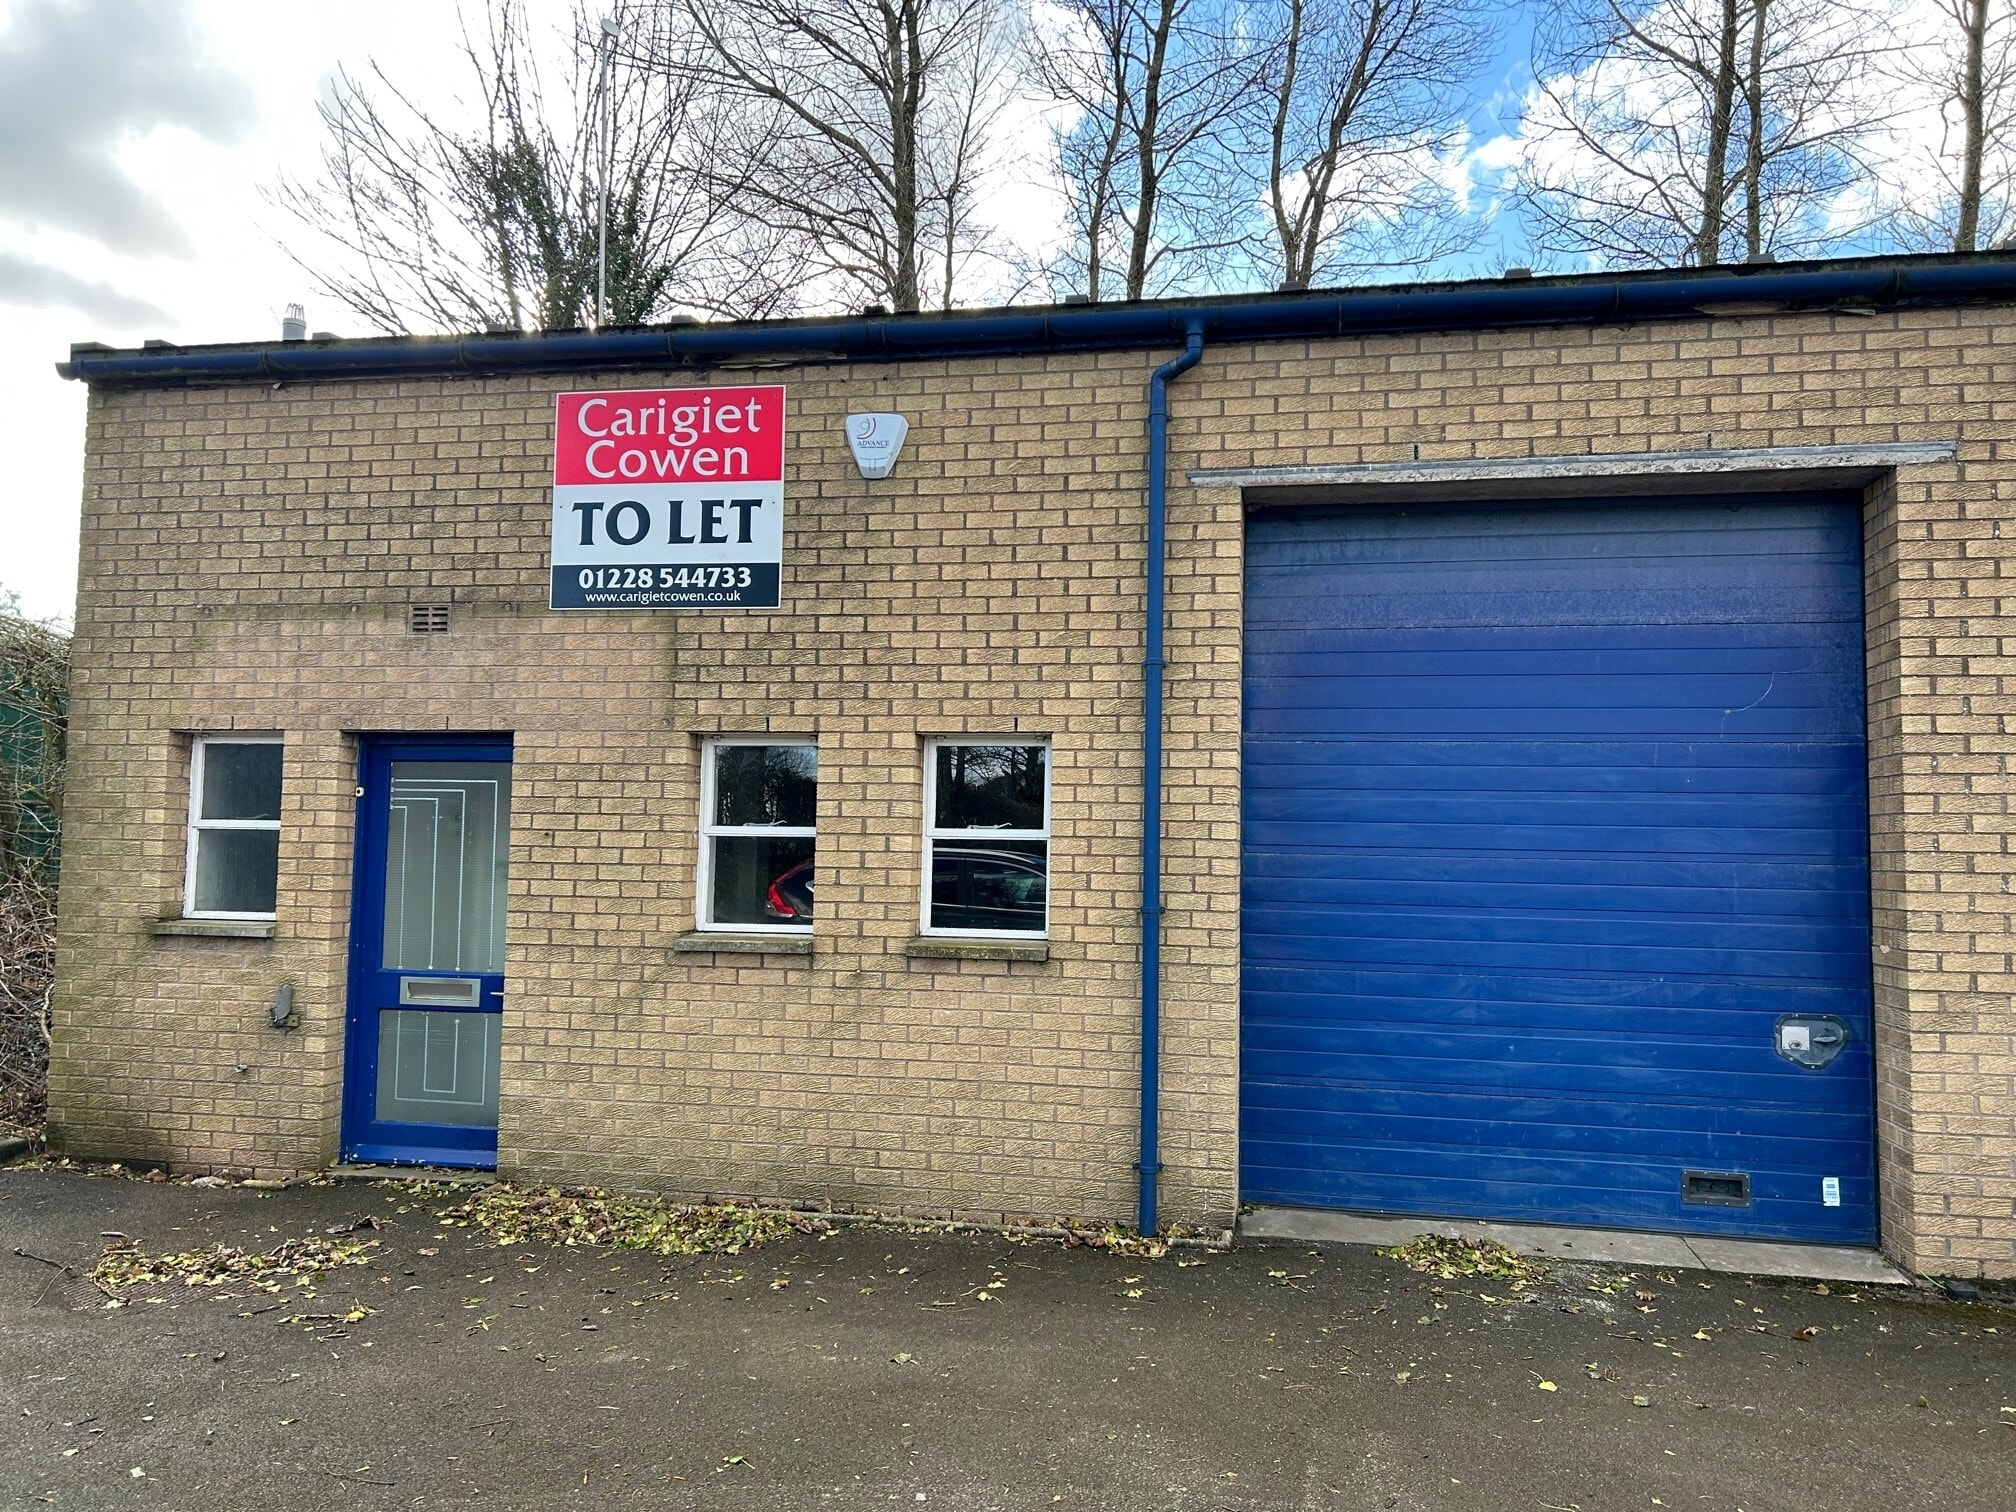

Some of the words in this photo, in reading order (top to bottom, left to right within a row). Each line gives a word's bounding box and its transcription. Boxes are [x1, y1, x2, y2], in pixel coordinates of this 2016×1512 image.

[577, 396, 762, 447] Carigiet
[585, 440, 749, 479] Cowen
[572, 500, 651, 546] TO
[667, 499, 763, 544] LET
[578, 568, 653, 590] 01228
[659, 566, 752, 589] 544733
[585, 590, 741, 605] www.carigietcowen.co.uk
